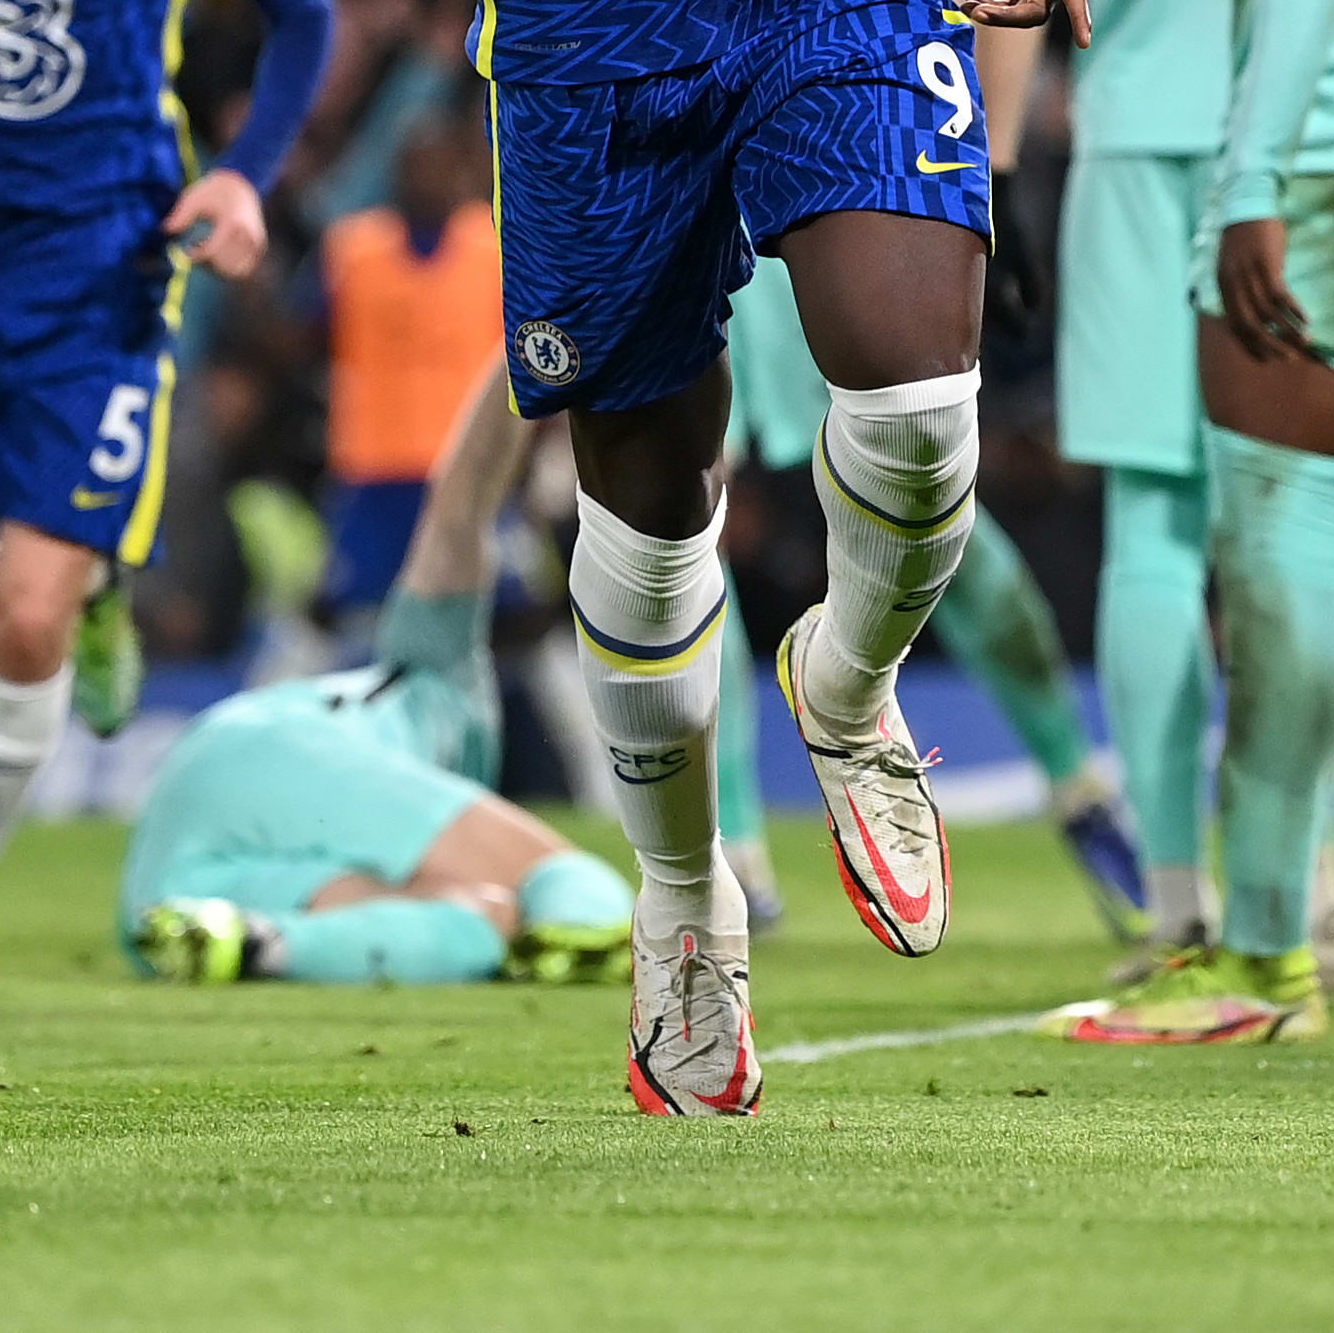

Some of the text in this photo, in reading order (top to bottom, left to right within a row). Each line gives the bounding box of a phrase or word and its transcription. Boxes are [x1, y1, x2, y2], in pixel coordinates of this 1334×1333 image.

[916, 40, 974, 139] 9
[522, 322, 563, 340] CHELSEA
[88, 384, 149, 484] 5
[609, 745, 687, 769] CFC
